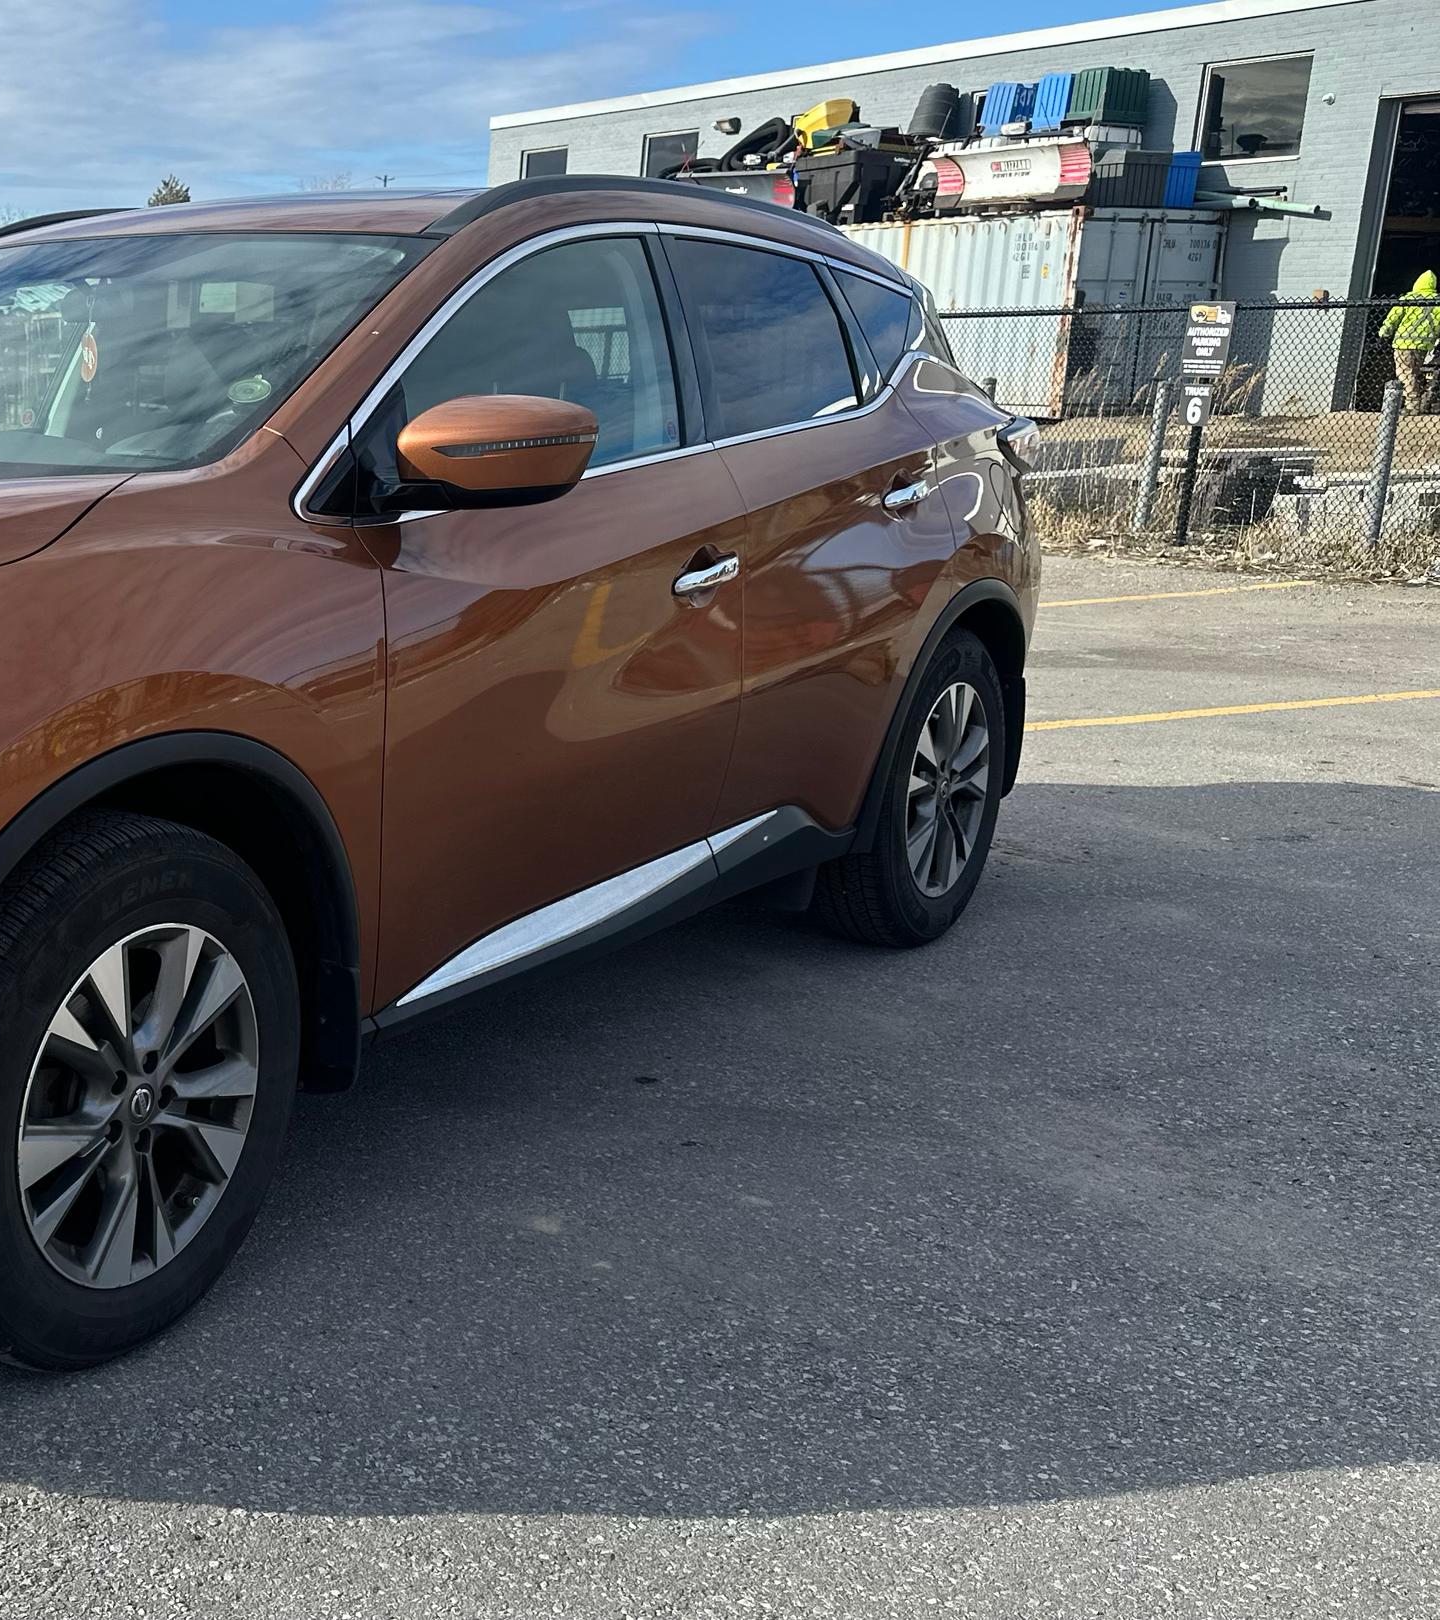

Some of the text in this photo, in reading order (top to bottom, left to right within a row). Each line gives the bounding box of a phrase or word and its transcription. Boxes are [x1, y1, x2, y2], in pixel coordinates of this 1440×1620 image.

[1186, 326, 1230, 337] AUTHORIZED
[1191, 337, 1222, 347] PARKING
[1195, 347, 1215, 356] ONLY
[1184, 386, 1210, 396] TRUCK
[1186, 397, 1202, 424] 6
